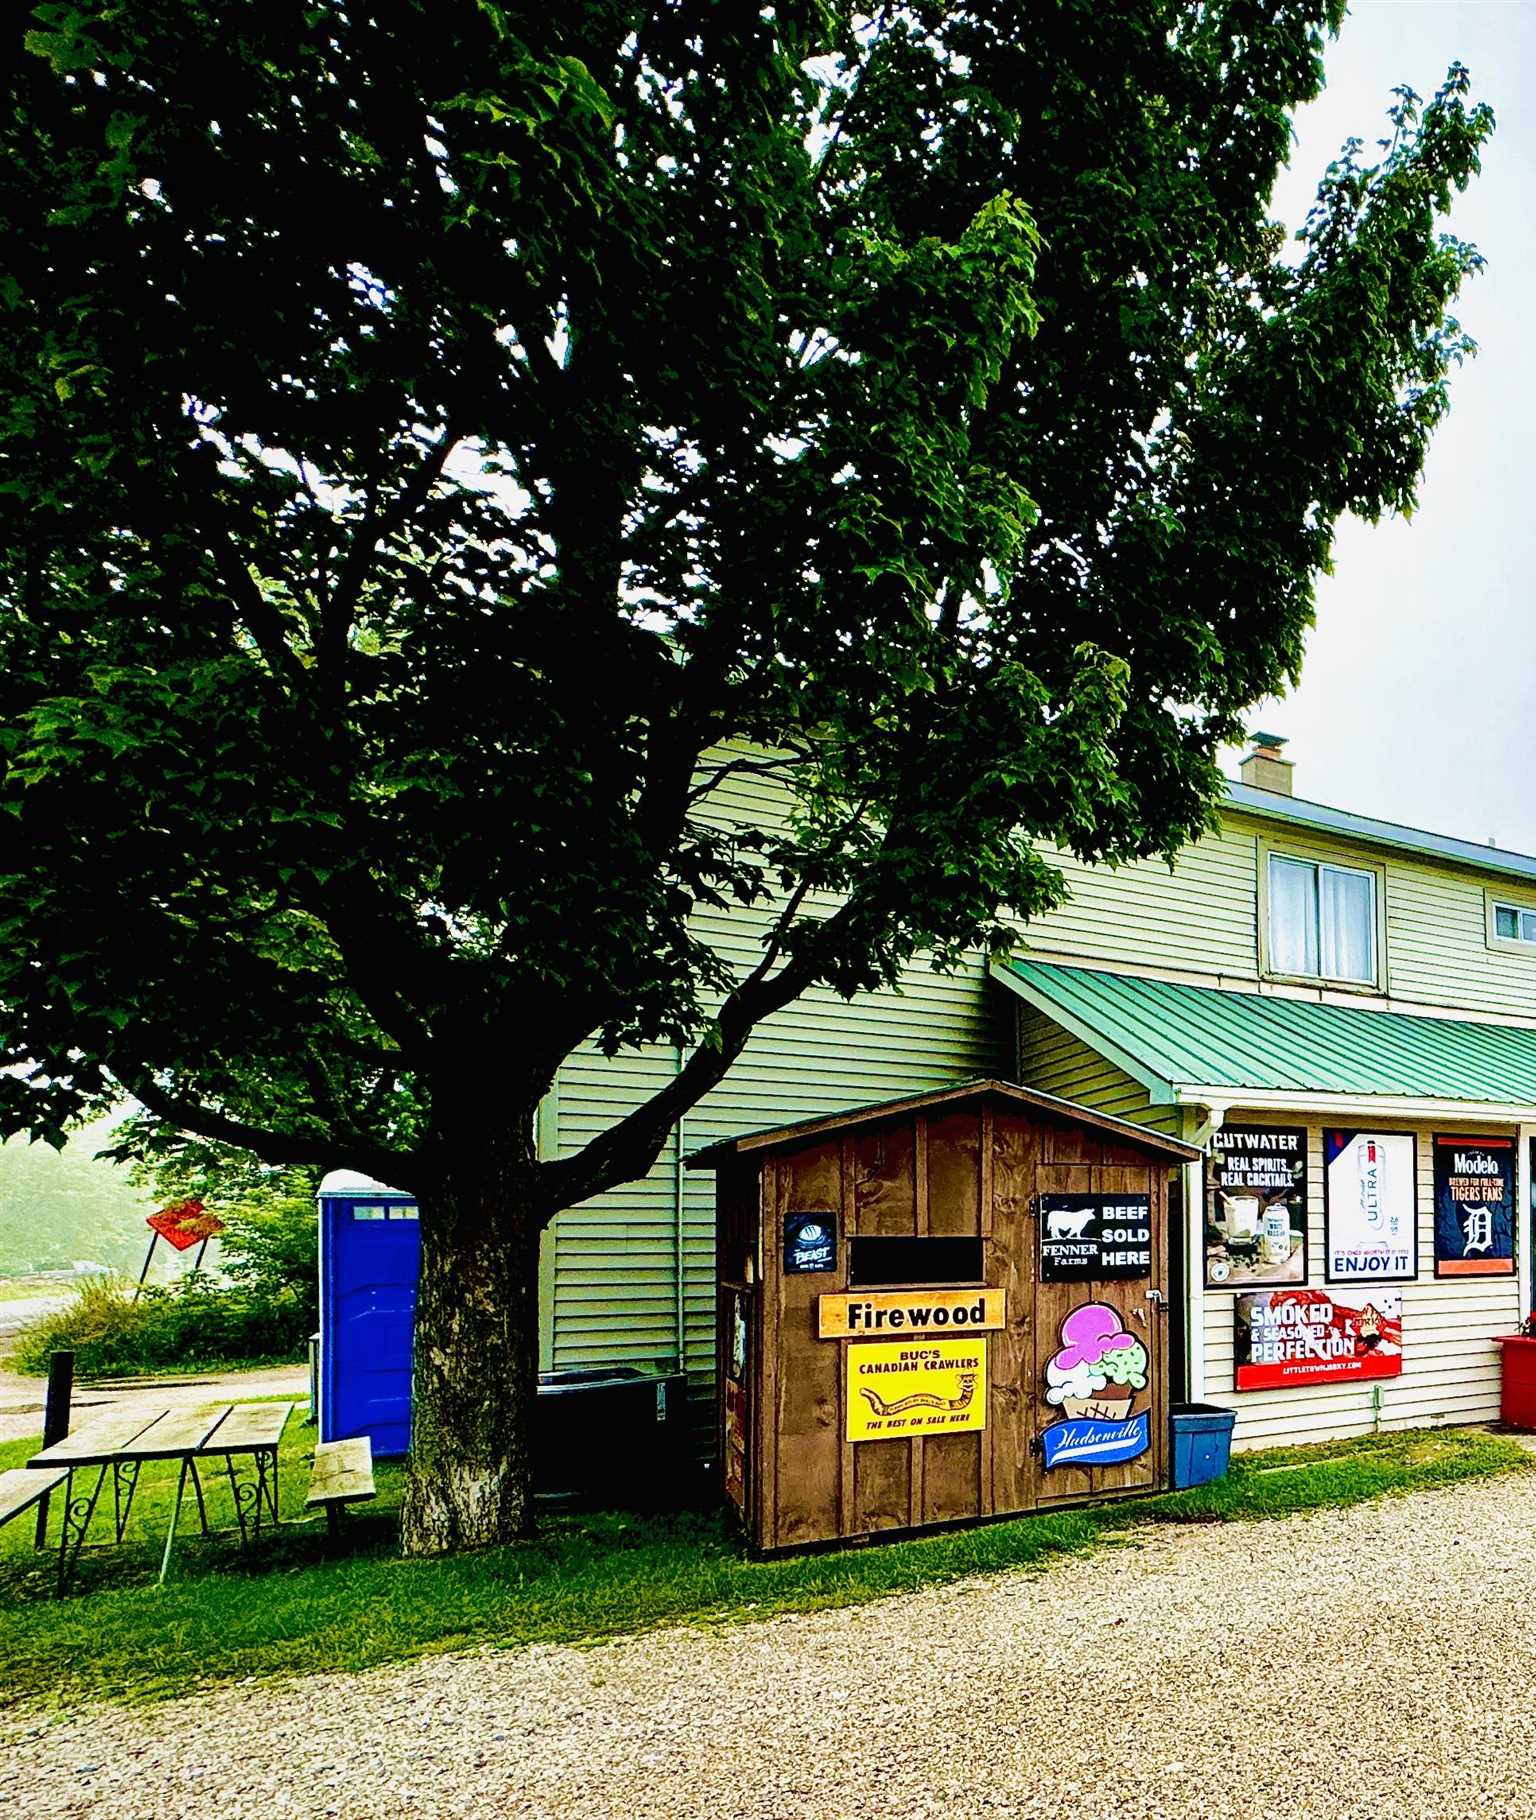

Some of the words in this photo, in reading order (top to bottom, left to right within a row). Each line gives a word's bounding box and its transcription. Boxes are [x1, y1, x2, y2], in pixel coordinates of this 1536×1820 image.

[1213, 1133, 1298, 1150] CUTWATER
[1227, 1157, 1251, 1171] REAL
[1454, 1153, 1498, 1174] Modelo
[1221, 1172, 1245, 1186] REAL
[1368, 1168, 1378, 1221] ULTRA
[1450, 1187, 1480, 1201] TIGERS
[1482, 1187, 1503, 1201] FANS
[1102, 1206, 1149, 1220] BEEF
[1101, 1229, 1150, 1243] SOLD
[792, 1246, 832, 1265] BEAST
[1042, 1244, 1099, 1256] FENNER
[1054, 1257, 1088, 1266] Farms
[1101, 1251, 1150, 1266] HERE
[1334, 1256, 1391, 1272] ENJOY
[1395, 1255, 1409, 1271] IT
[848, 1297, 986, 1329] Firewood
[1250, 1303, 1333, 1326] SMOKED
[900, 1350, 941, 1361] BUC'S
[860, 1362, 918, 1375] CANADIAN
[924, 1358, 979, 1371] CRAWLERS
[866, 1421, 883, 1430] THE
[887, 1419, 907, 1428] BEST
[911, 1417, 924, 1426] ON
[927, 1416, 947, 1424] SALE
[950, 1414, 971, 1423] HERE
[1054, 1419, 1143, 1449] Hudsonville
